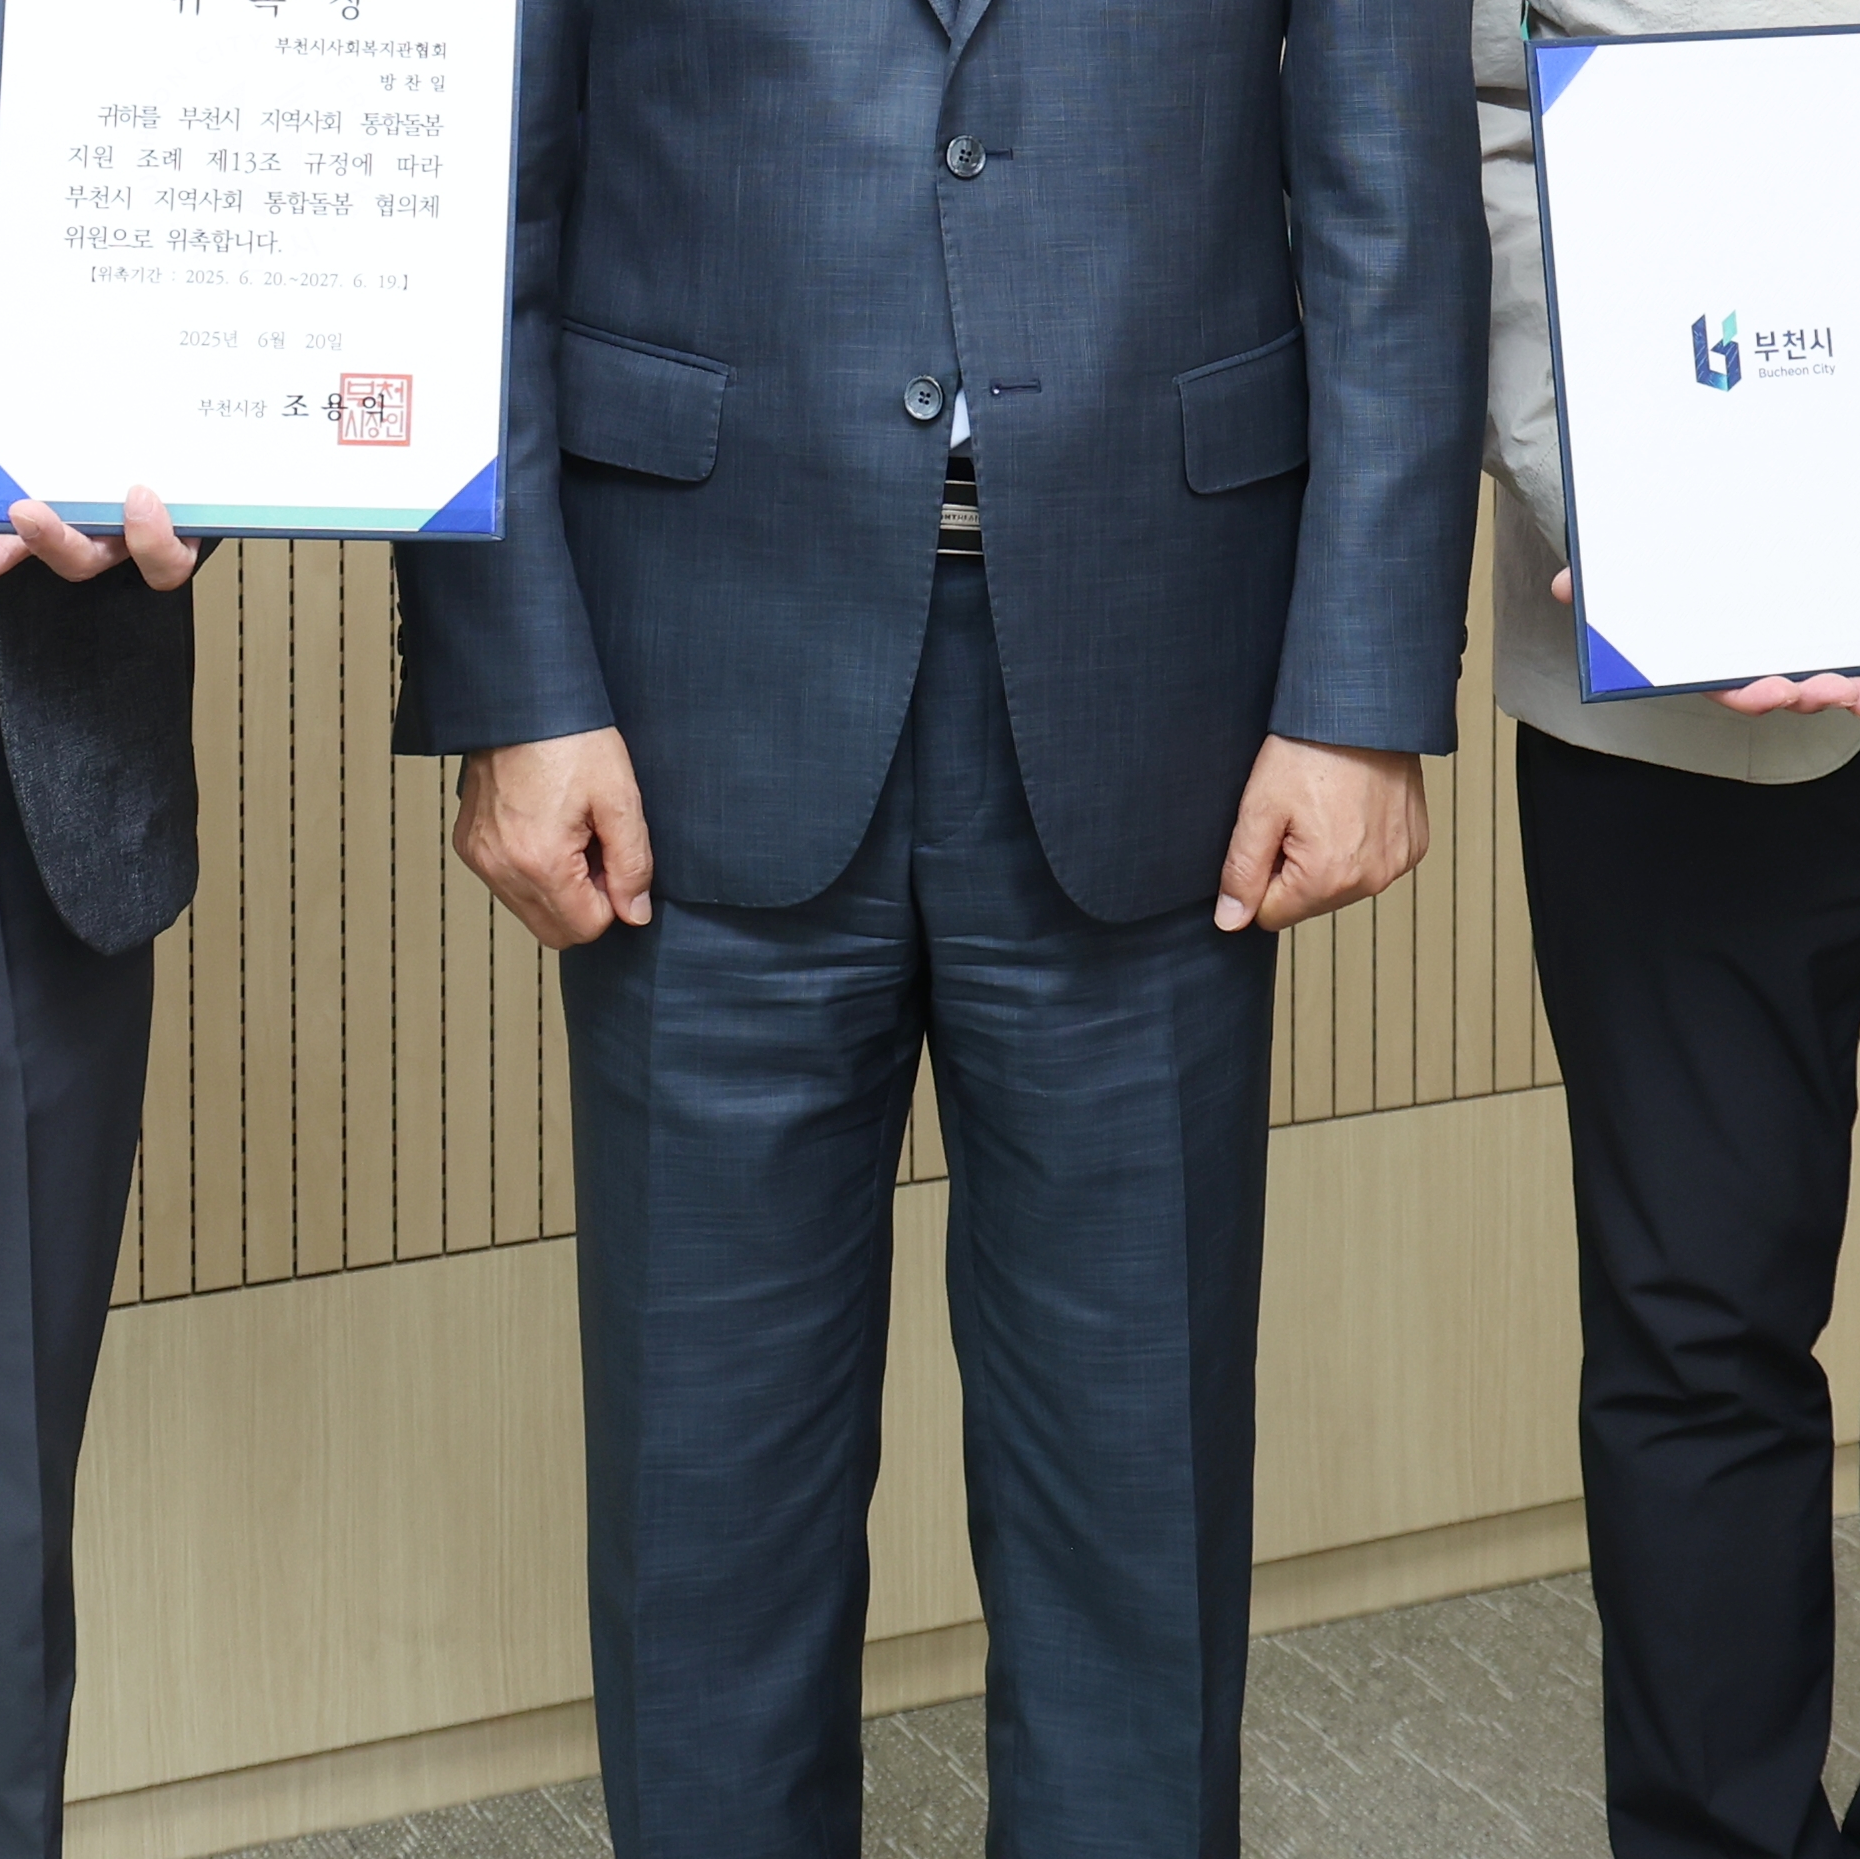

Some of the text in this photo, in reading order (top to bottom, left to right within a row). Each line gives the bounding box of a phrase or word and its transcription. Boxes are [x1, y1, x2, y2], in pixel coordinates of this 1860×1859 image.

[275, 37, 447, 60] 부천시사회복지관협회
[97, 103, 445, 138] 귀하를 부천시 지역사회 통합돌봄
[68, 144, 444, 179] 지원 조례 제13조 규정에 따라
[64, 184, 440, 219] 부천시 지역사회 통합돌봄 협의체
[63, 224, 154, 250] 위원으로
[166, 227, 282, 255] 위촉합니다.
[185, 269, 229, 286] 2025.
[179, 329, 342, 352] 2025년 6월 20일
[1753, 326, 1834, 363] 부천시
[1758, 363, 1836, 379] Bucheon City
[197, 398, 269, 419] 부천시장
